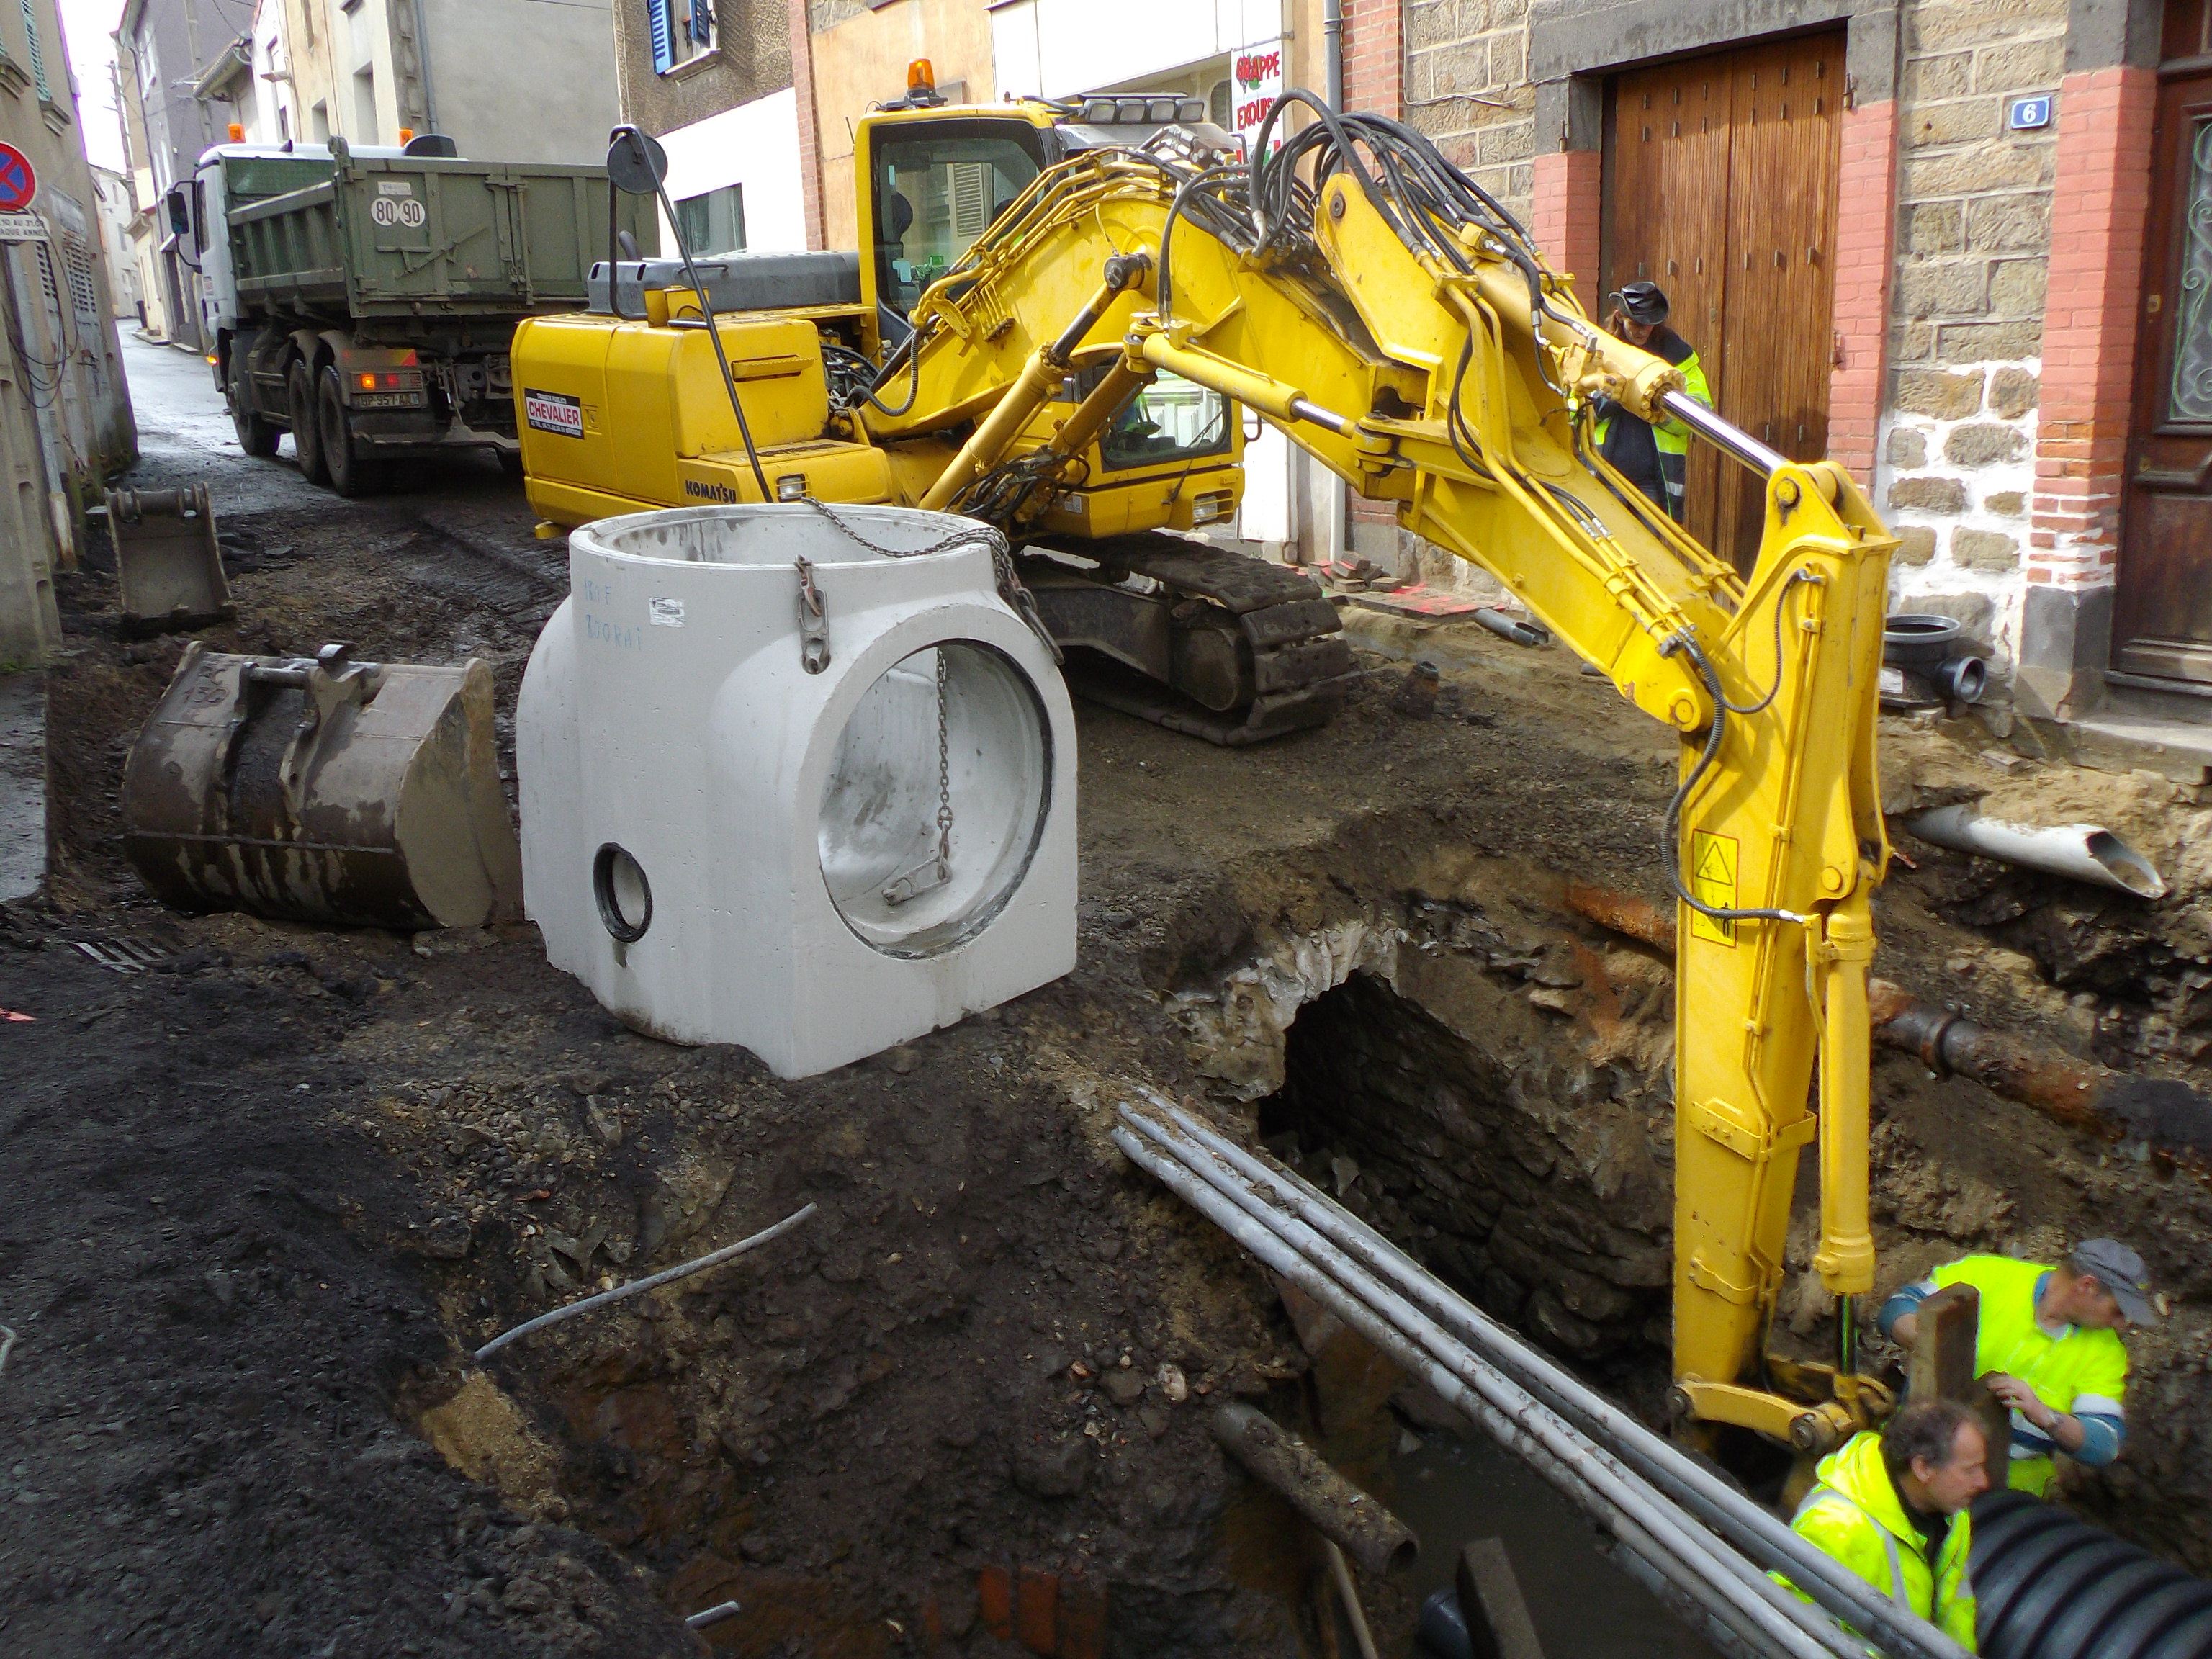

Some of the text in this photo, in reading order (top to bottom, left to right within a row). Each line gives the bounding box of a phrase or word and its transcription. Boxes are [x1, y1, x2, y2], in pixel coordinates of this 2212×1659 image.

[1236, 51, 1280, 81] GRAPPE
[2023, 103, 2036, 123] 6
[377, 201, 394, 223] 80
[403, 202, 421, 224] 90
[529, 400, 580, 426] CHEVALIER
[685, 480, 737, 504] KOMATSU
